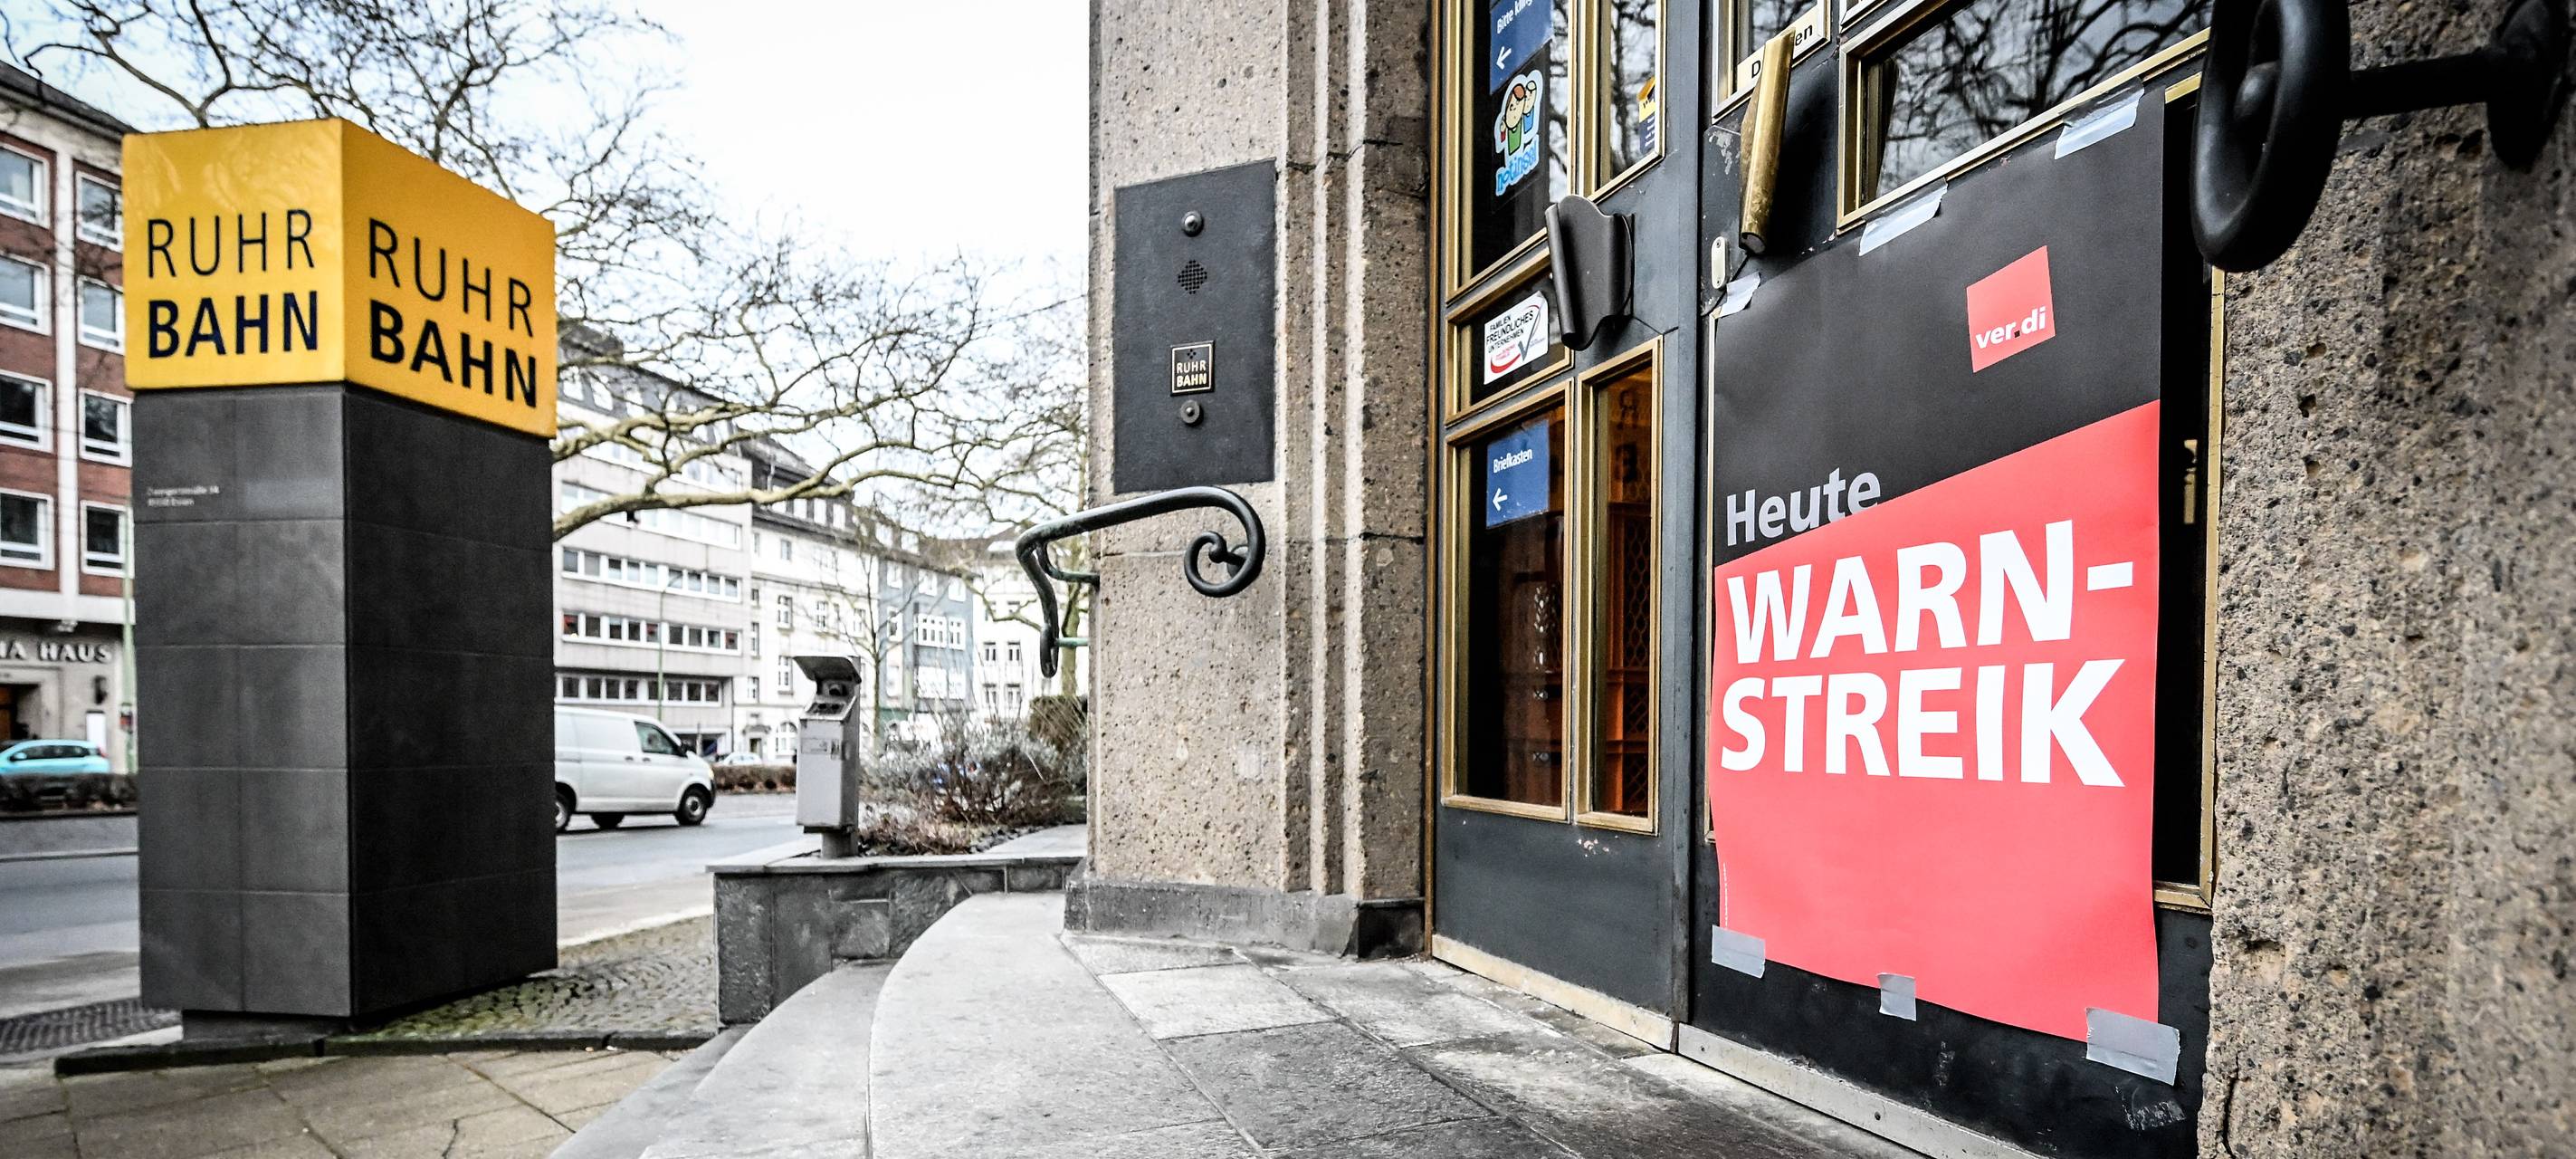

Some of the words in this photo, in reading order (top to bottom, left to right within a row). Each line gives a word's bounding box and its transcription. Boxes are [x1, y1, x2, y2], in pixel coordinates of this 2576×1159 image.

[148, 209, 315, 279] RUHR
[369, 217, 534, 338] RUHR
[148, 290, 318, 359] BAHN
[369, 299, 537, 409] BAHN
[1486, 310, 1534, 343] FREUNDLICHES
[1975, 306, 2046, 349] ver.di
[1176, 359, 1207, 374] RUHR
[1176, 372, 1207, 388] BAHN
[1493, 448, 1533, 474] Briefkasten
[1726, 467, 1882, 546] Heute
[1727, 520, 2134, 665] WARN-
[39, 641, 113, 664] HAUS
[1720, 658, 2126, 788] STREIK
